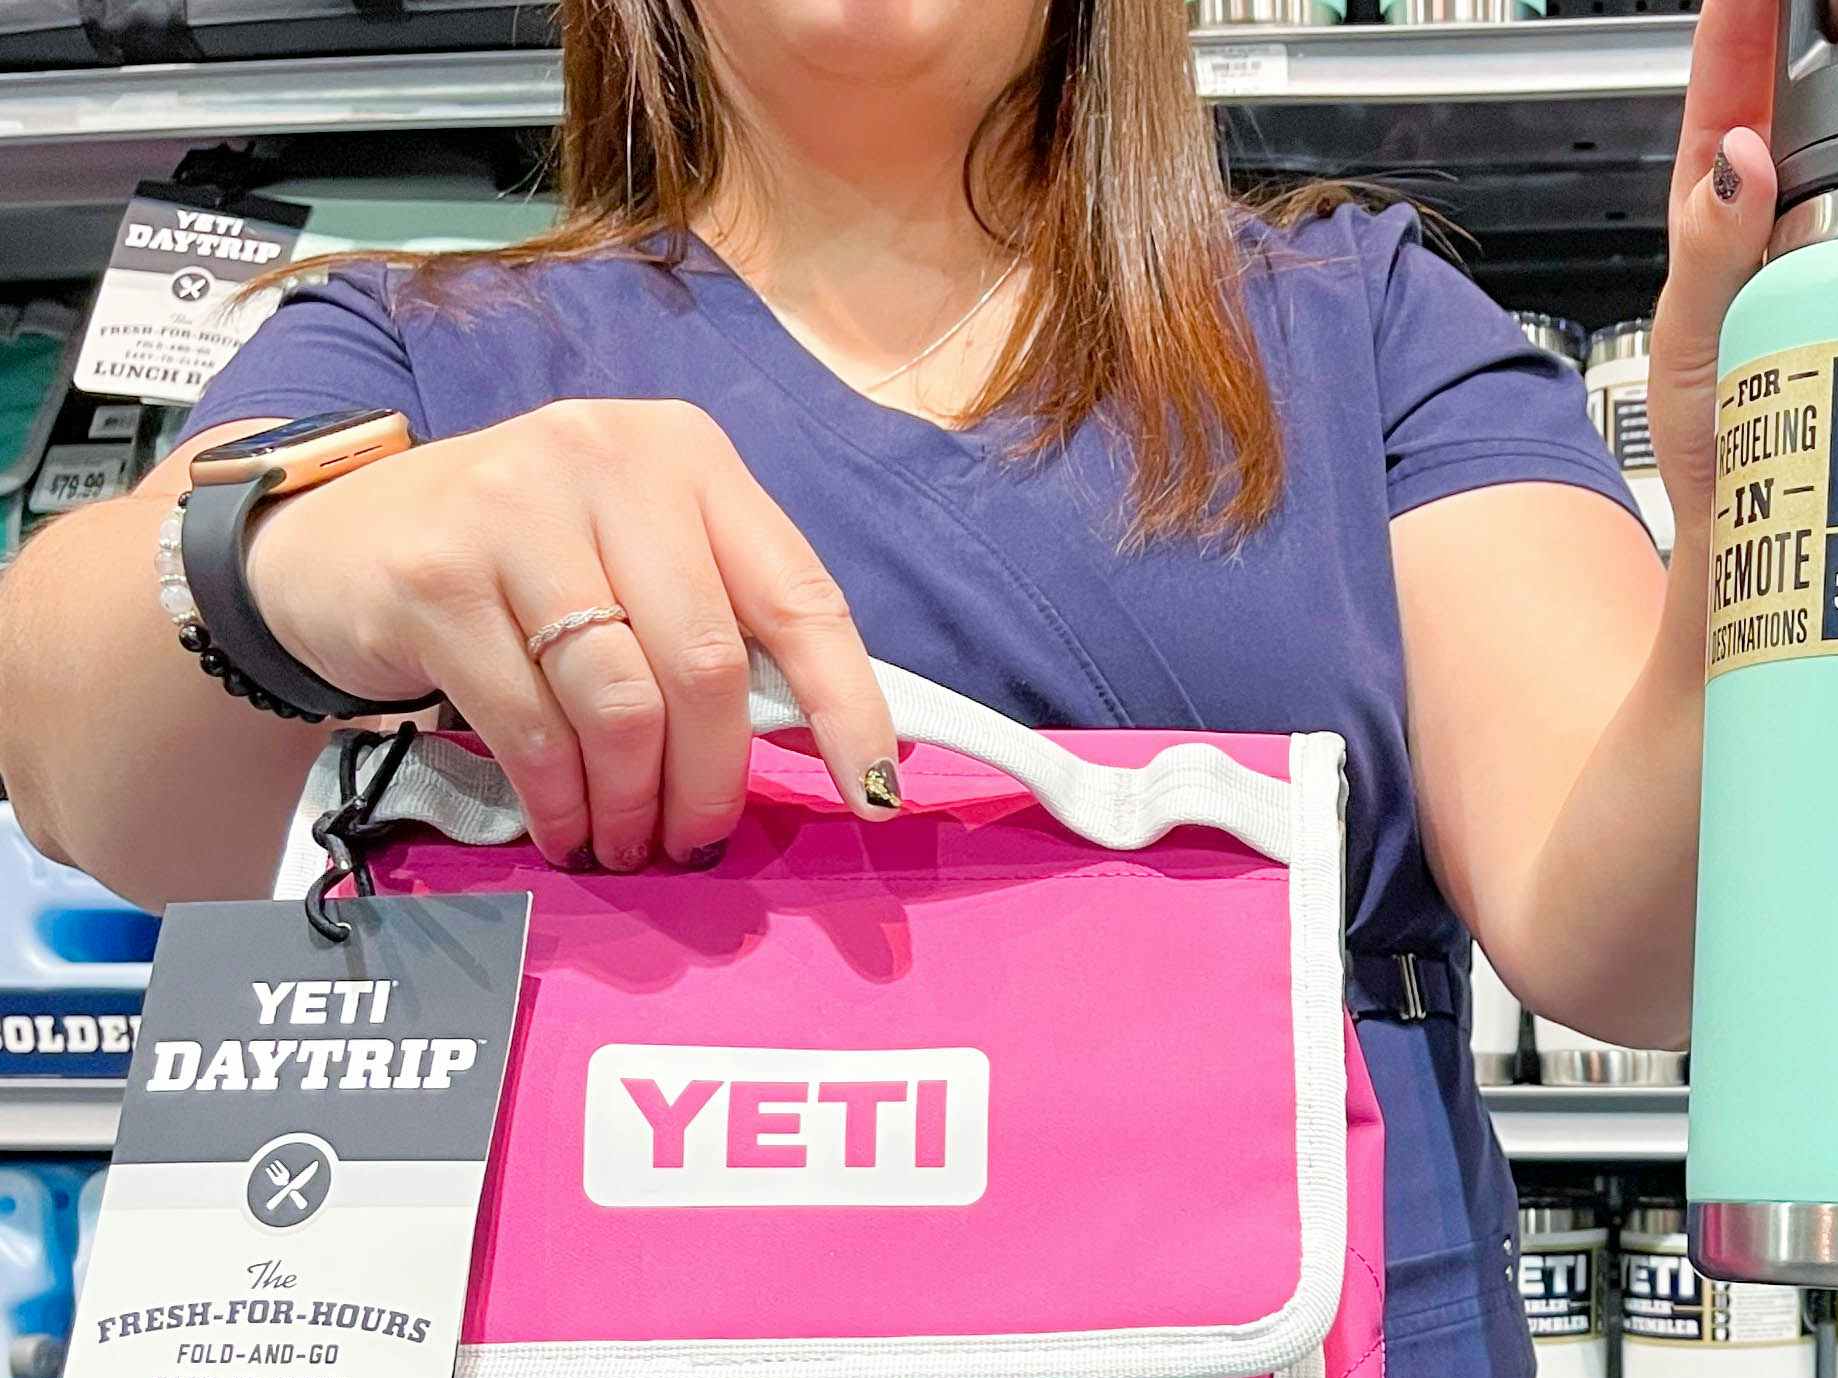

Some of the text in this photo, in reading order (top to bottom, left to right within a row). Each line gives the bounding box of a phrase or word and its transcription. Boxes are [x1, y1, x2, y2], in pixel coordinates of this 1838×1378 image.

[125, 224, 282, 264] DAYTRIP
[100, 325, 244, 348] FRESH-FOR-HOUR
[93, 361, 177, 384] LUNCH
[1737, 368, 1781, 408] FOR
[1716, 405, 1818, 480] REFUELING
[1734, 477, 1776, 529] IN
[1712, 529, 1812, 614] REMOTE
[1711, 608, 1808, 665] DESTINATIONS
[252, 979, 392, 1025] YETI
[0, 1014, 142, 1054] OLDE
[146, 1037, 479, 1092] DAYTRIP
[619, 1076, 949, 1169] YETI
[247, 1260, 299, 1290] The
[1519, 1253, 1587, 1295] ETI
[97, 1299, 431, 1344] FRESH-FOR-HOURS
[1528, 1314, 1590, 1334] UMBLER
[176, 1344, 339, 1366] FOLD-AND-GO
